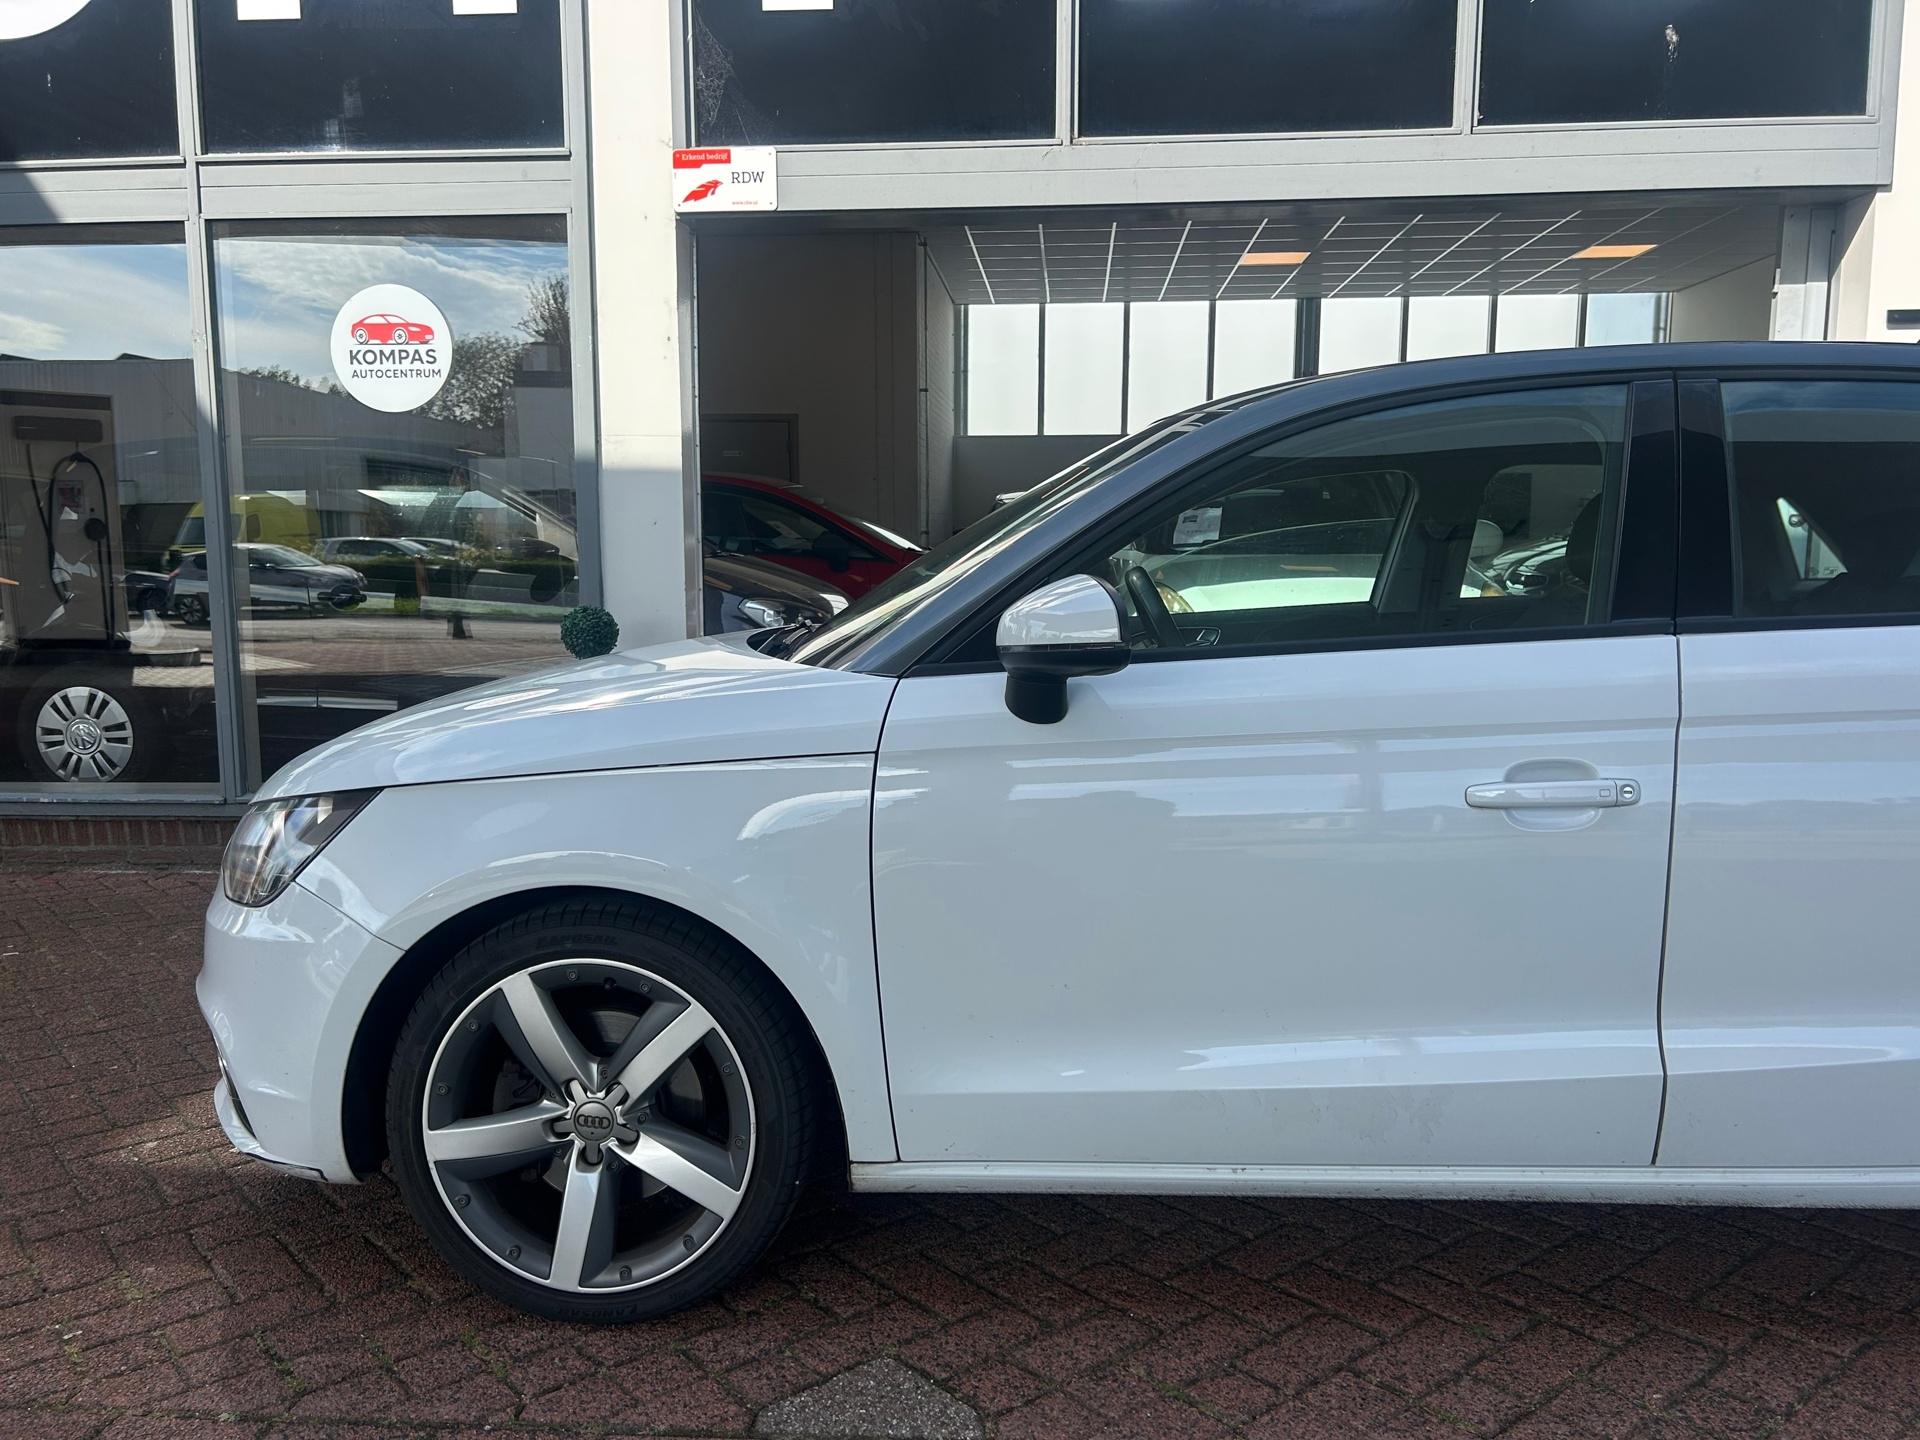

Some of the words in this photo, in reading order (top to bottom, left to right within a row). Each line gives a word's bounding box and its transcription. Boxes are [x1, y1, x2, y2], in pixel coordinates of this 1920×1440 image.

[681, 153, 705, 161] Erkend
[706, 152, 728, 161] bedrijf
[731, 171, 765, 184] RDW
[349, 348, 437, 365] KOMPAS
[351, 368, 442, 379] AUTOCENTRUM
